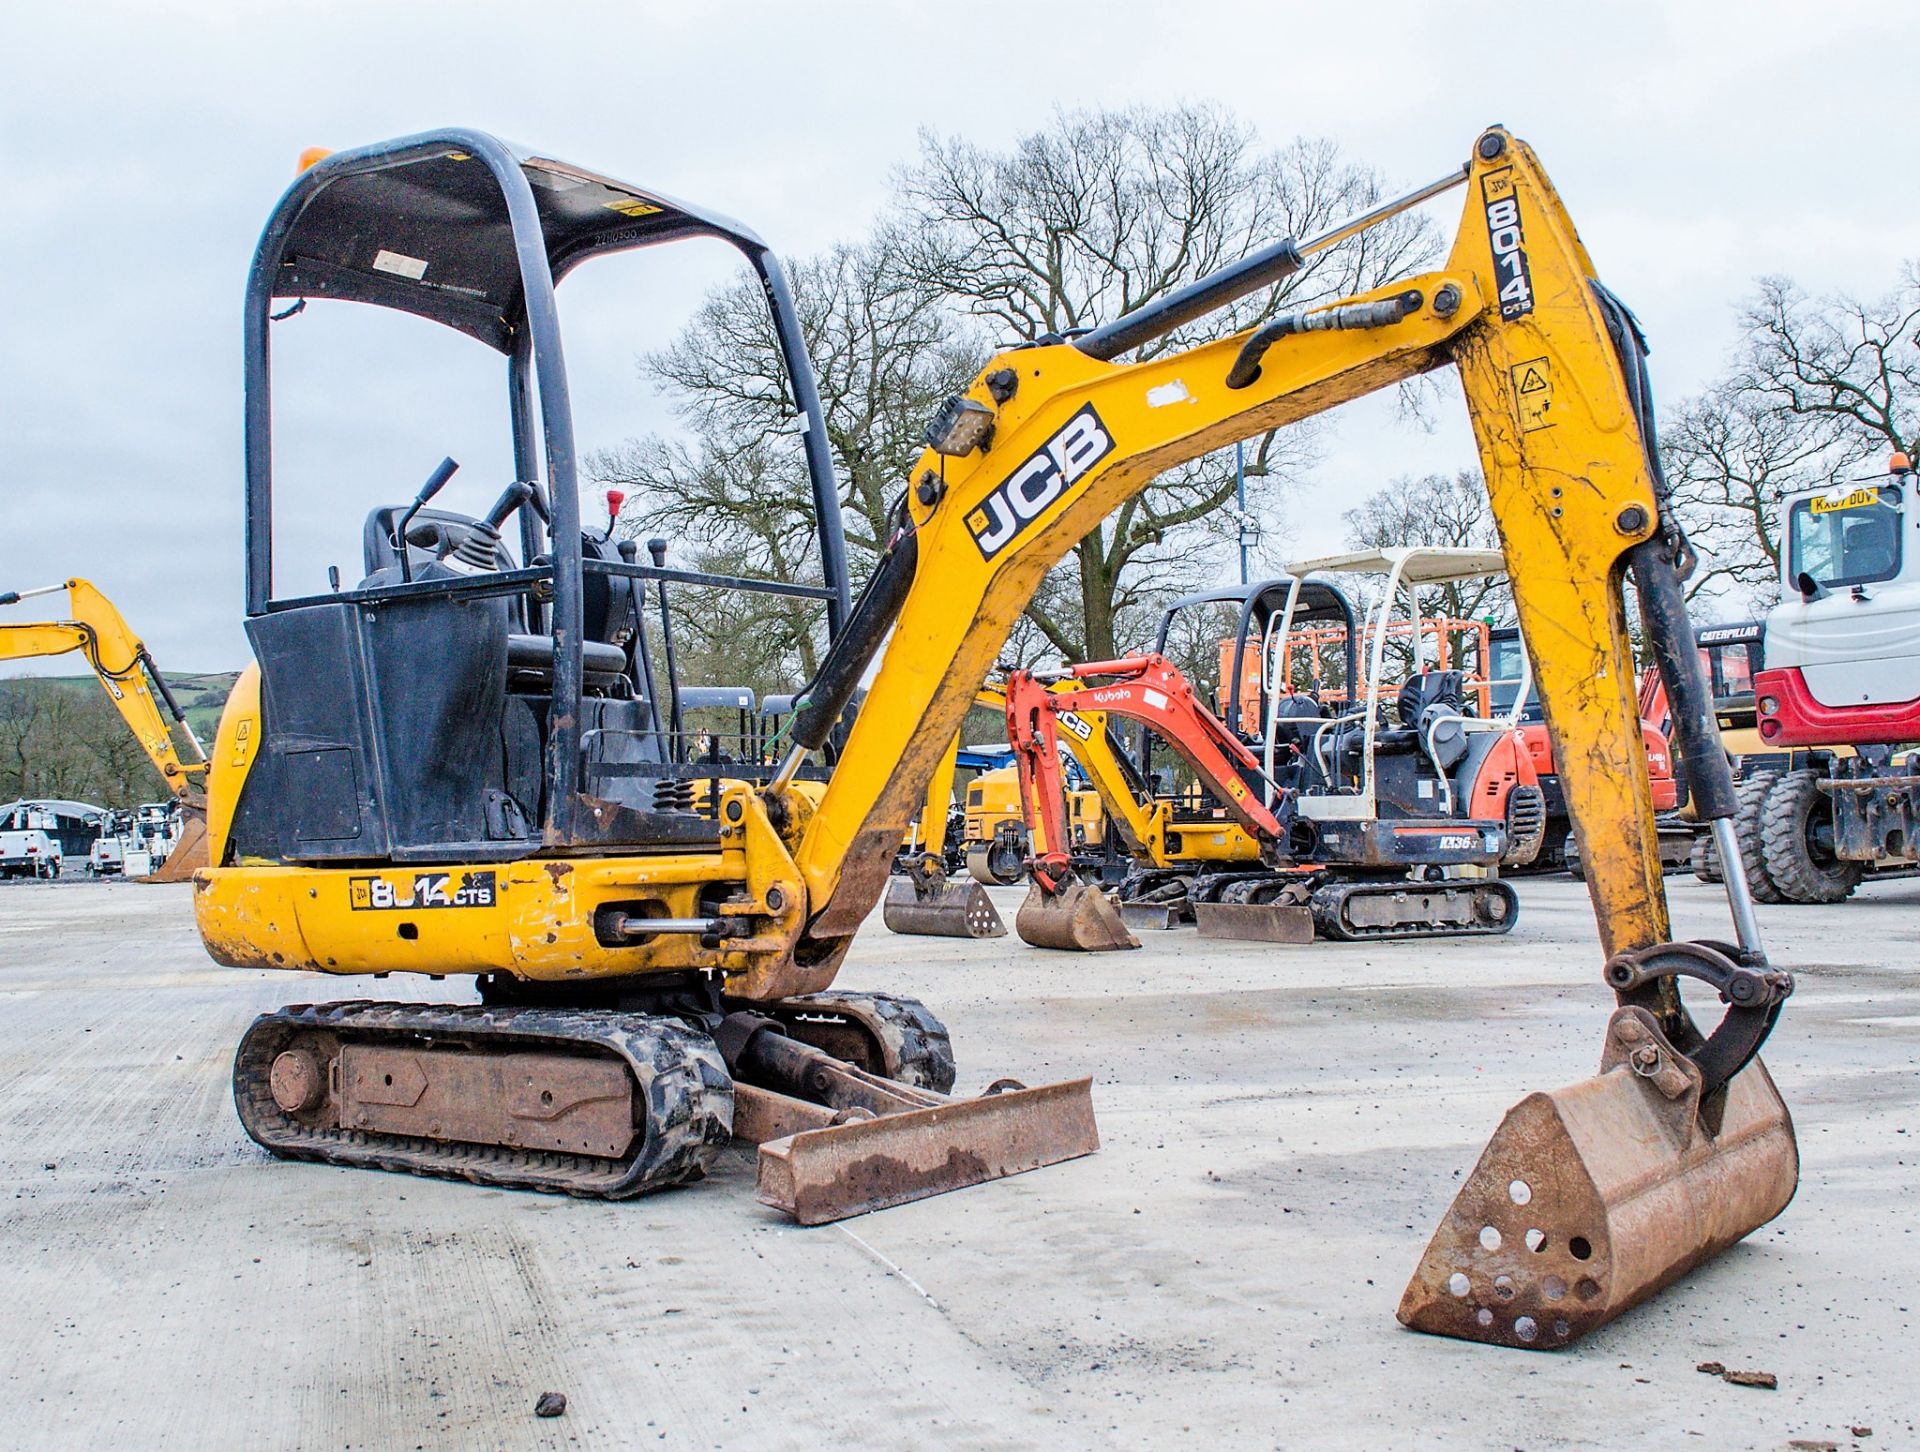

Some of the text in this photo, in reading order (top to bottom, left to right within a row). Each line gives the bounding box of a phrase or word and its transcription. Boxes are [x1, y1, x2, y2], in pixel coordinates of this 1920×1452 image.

[1488, 200, 1531, 302] 8014
[978, 413, 1108, 553] JCB
[1700, 626, 1759, 641] CATERPILLAR
[1094, 688, 1131, 703] Kubota
[454, 889, 491, 905] CTS
